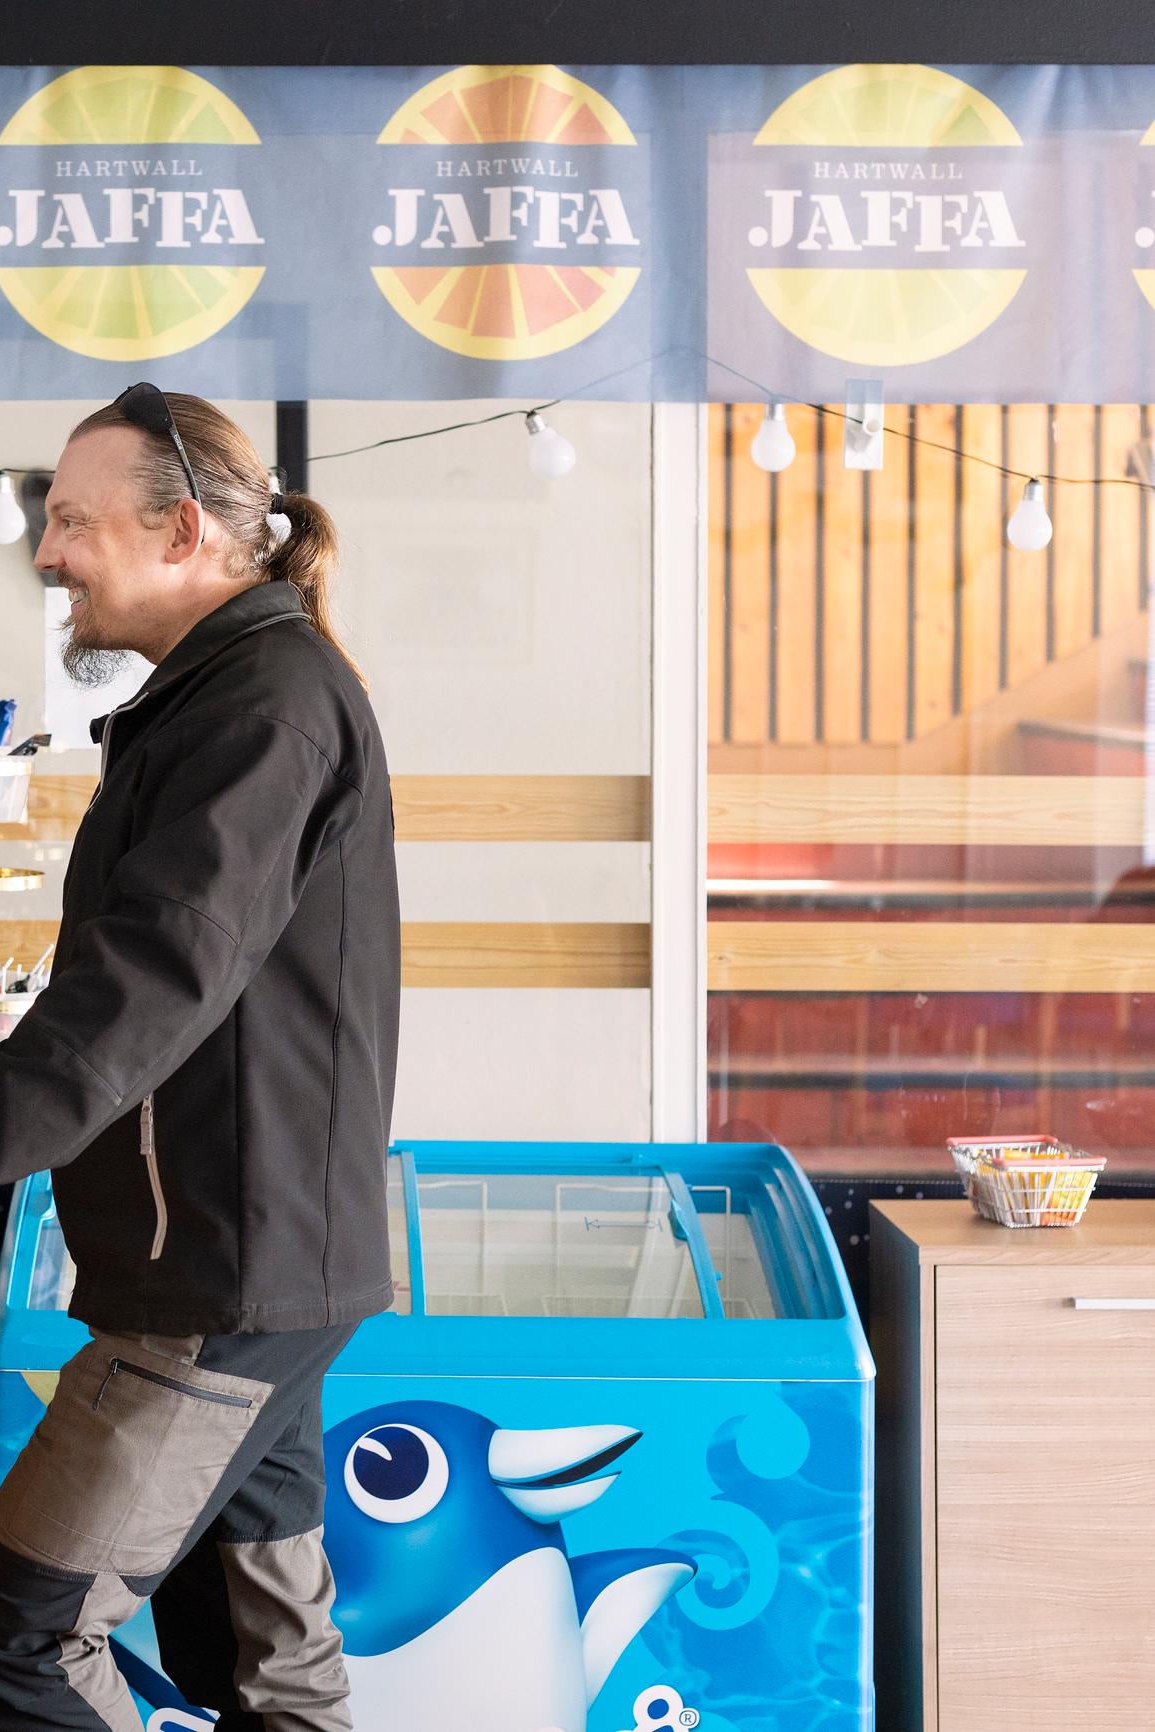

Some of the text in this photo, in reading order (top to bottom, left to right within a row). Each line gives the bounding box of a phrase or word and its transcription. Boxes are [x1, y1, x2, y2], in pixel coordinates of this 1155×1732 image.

[55, 158, 204, 177] HARTWALL
[435, 157, 579, 178] HARTWALL
[813, 160, 963, 181] HARTWALL
[372, 186, 641, 250] JAFFA
[747, 189, 1027, 252] JAFFA
